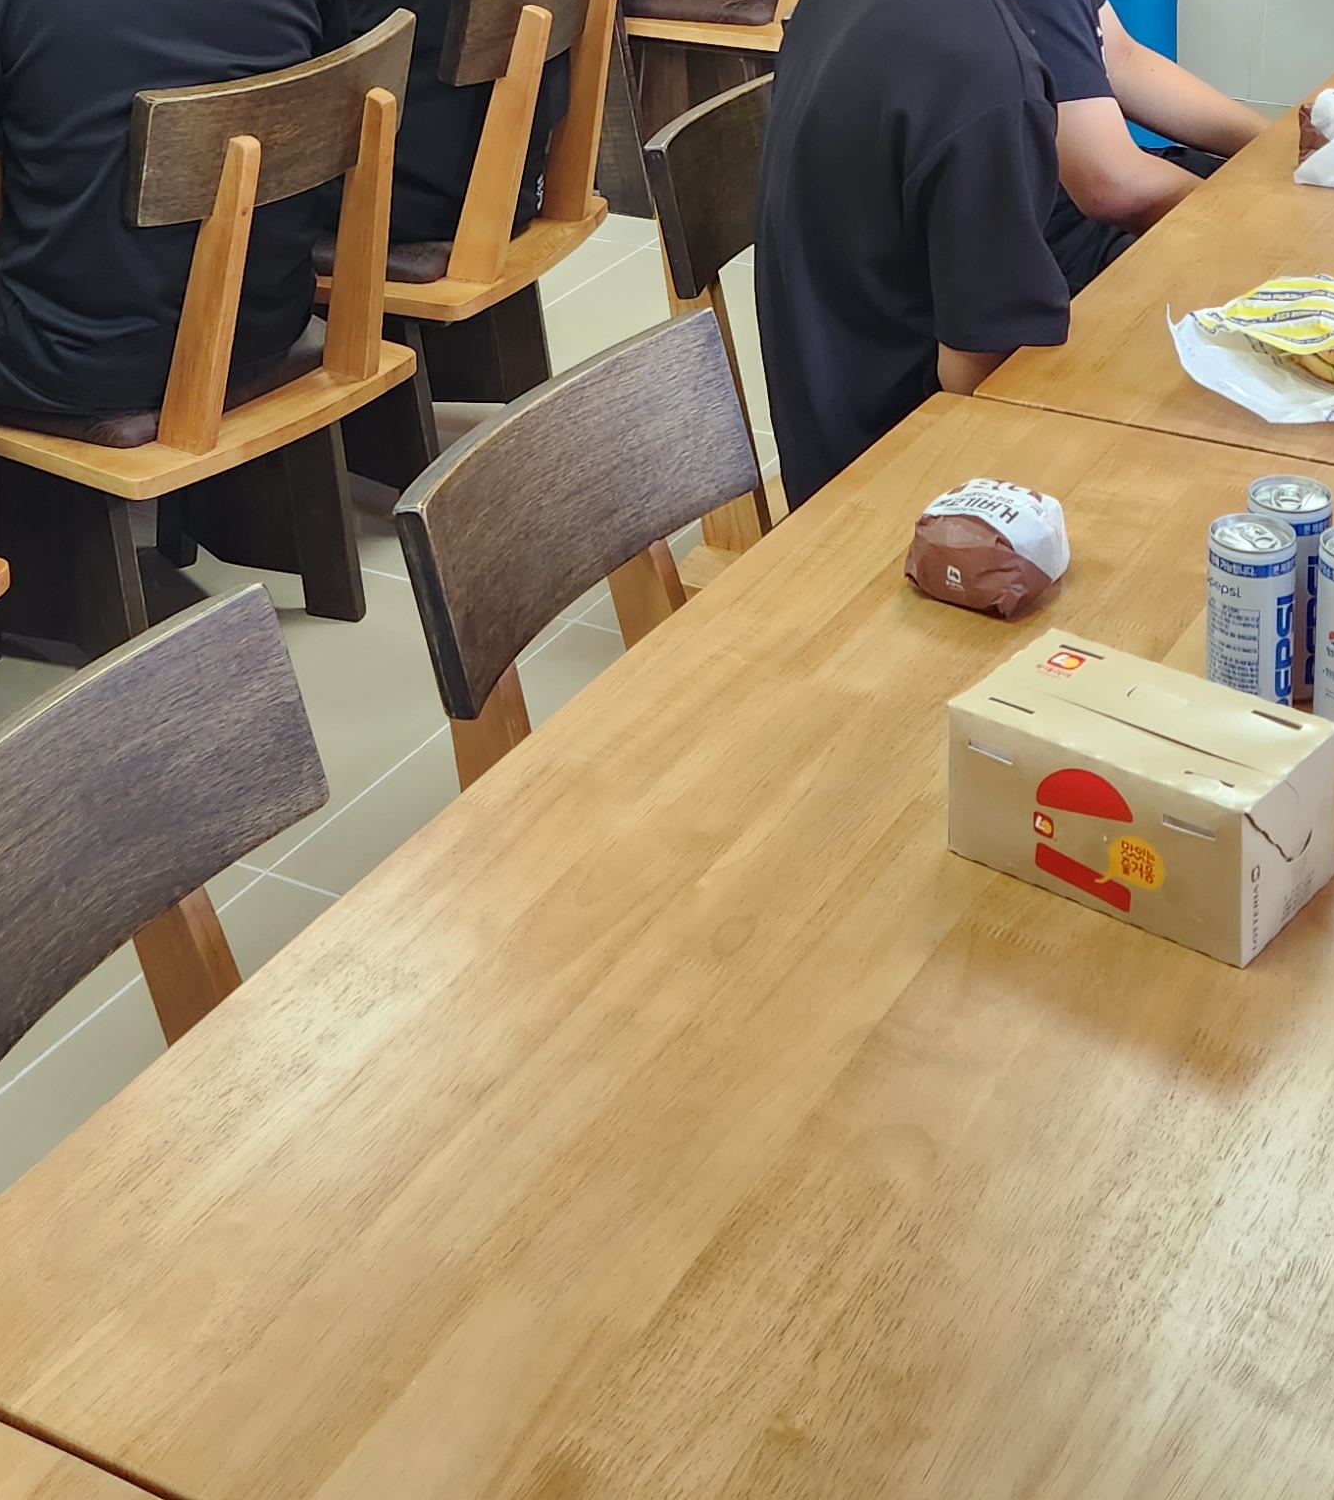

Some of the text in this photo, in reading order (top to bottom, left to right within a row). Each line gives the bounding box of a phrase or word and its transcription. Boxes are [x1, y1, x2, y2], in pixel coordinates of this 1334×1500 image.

[1275, 594, 1294, 707] EPSI
[1120, 840, 1156, 866] 맛있는
[1120, 856, 1156, 885] 즐거움
